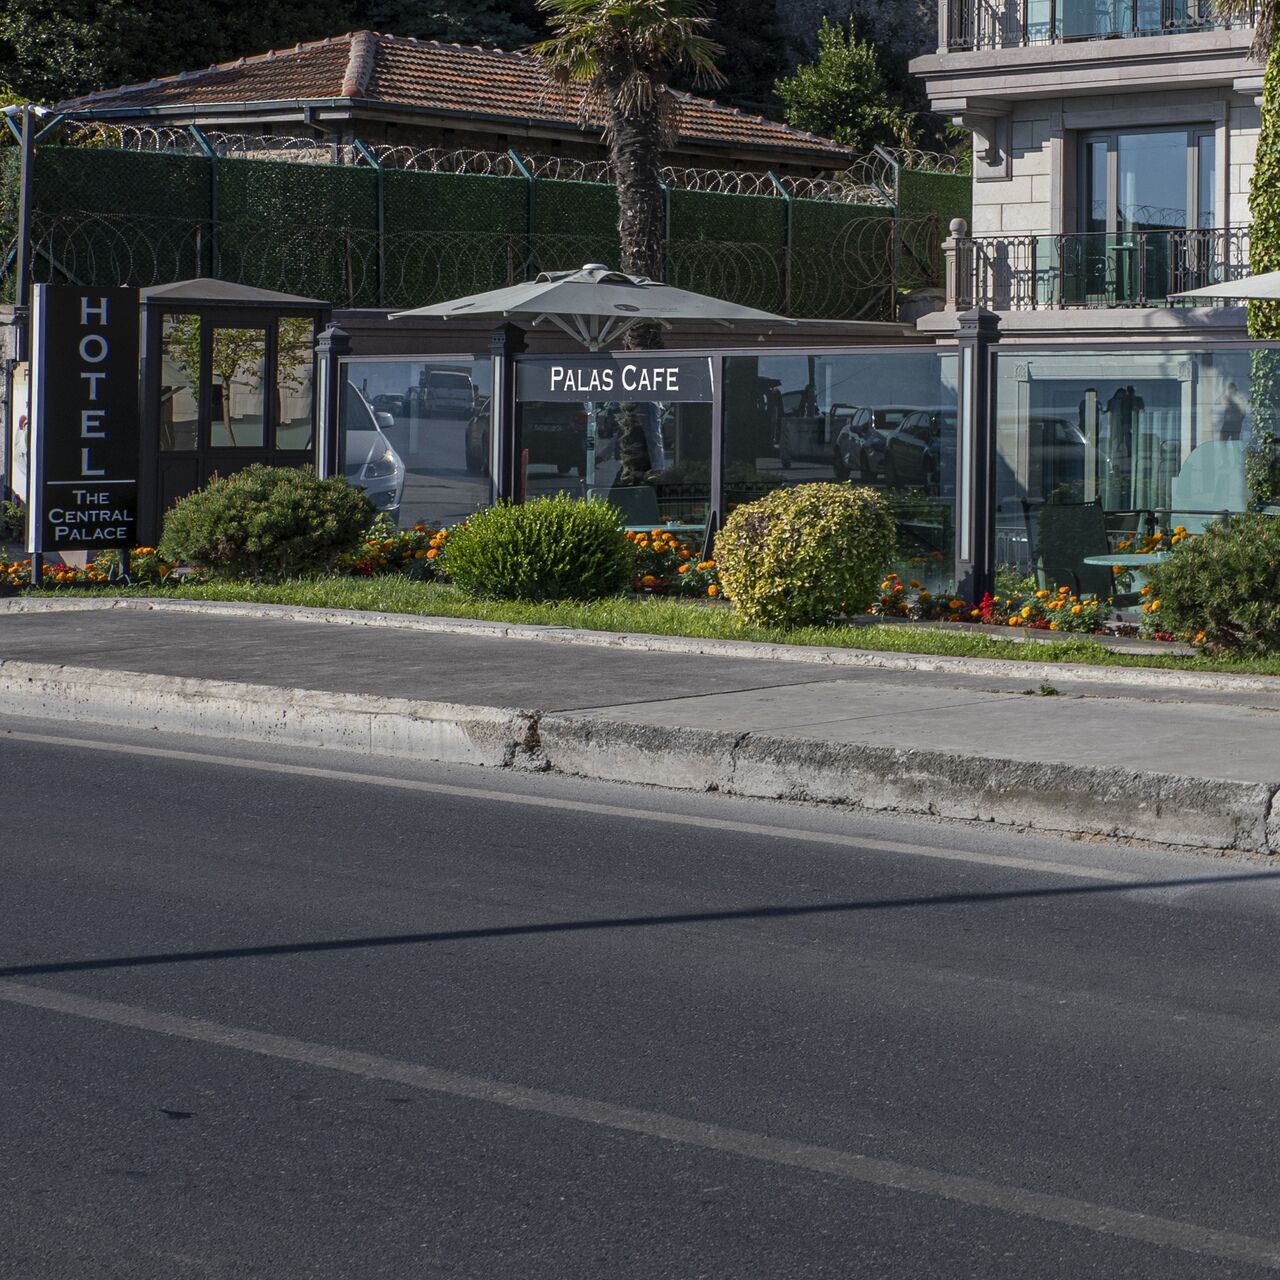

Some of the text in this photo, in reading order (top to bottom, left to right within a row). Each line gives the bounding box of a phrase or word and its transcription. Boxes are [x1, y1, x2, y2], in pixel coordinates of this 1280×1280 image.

[550, 365, 679, 391] PALAS CAFE
[79, 297, 108, 476] HOTEL
[72, 490, 110, 504] THE
[48, 508, 134, 523] CENTRAL
[55, 526, 127, 541] PALACE
